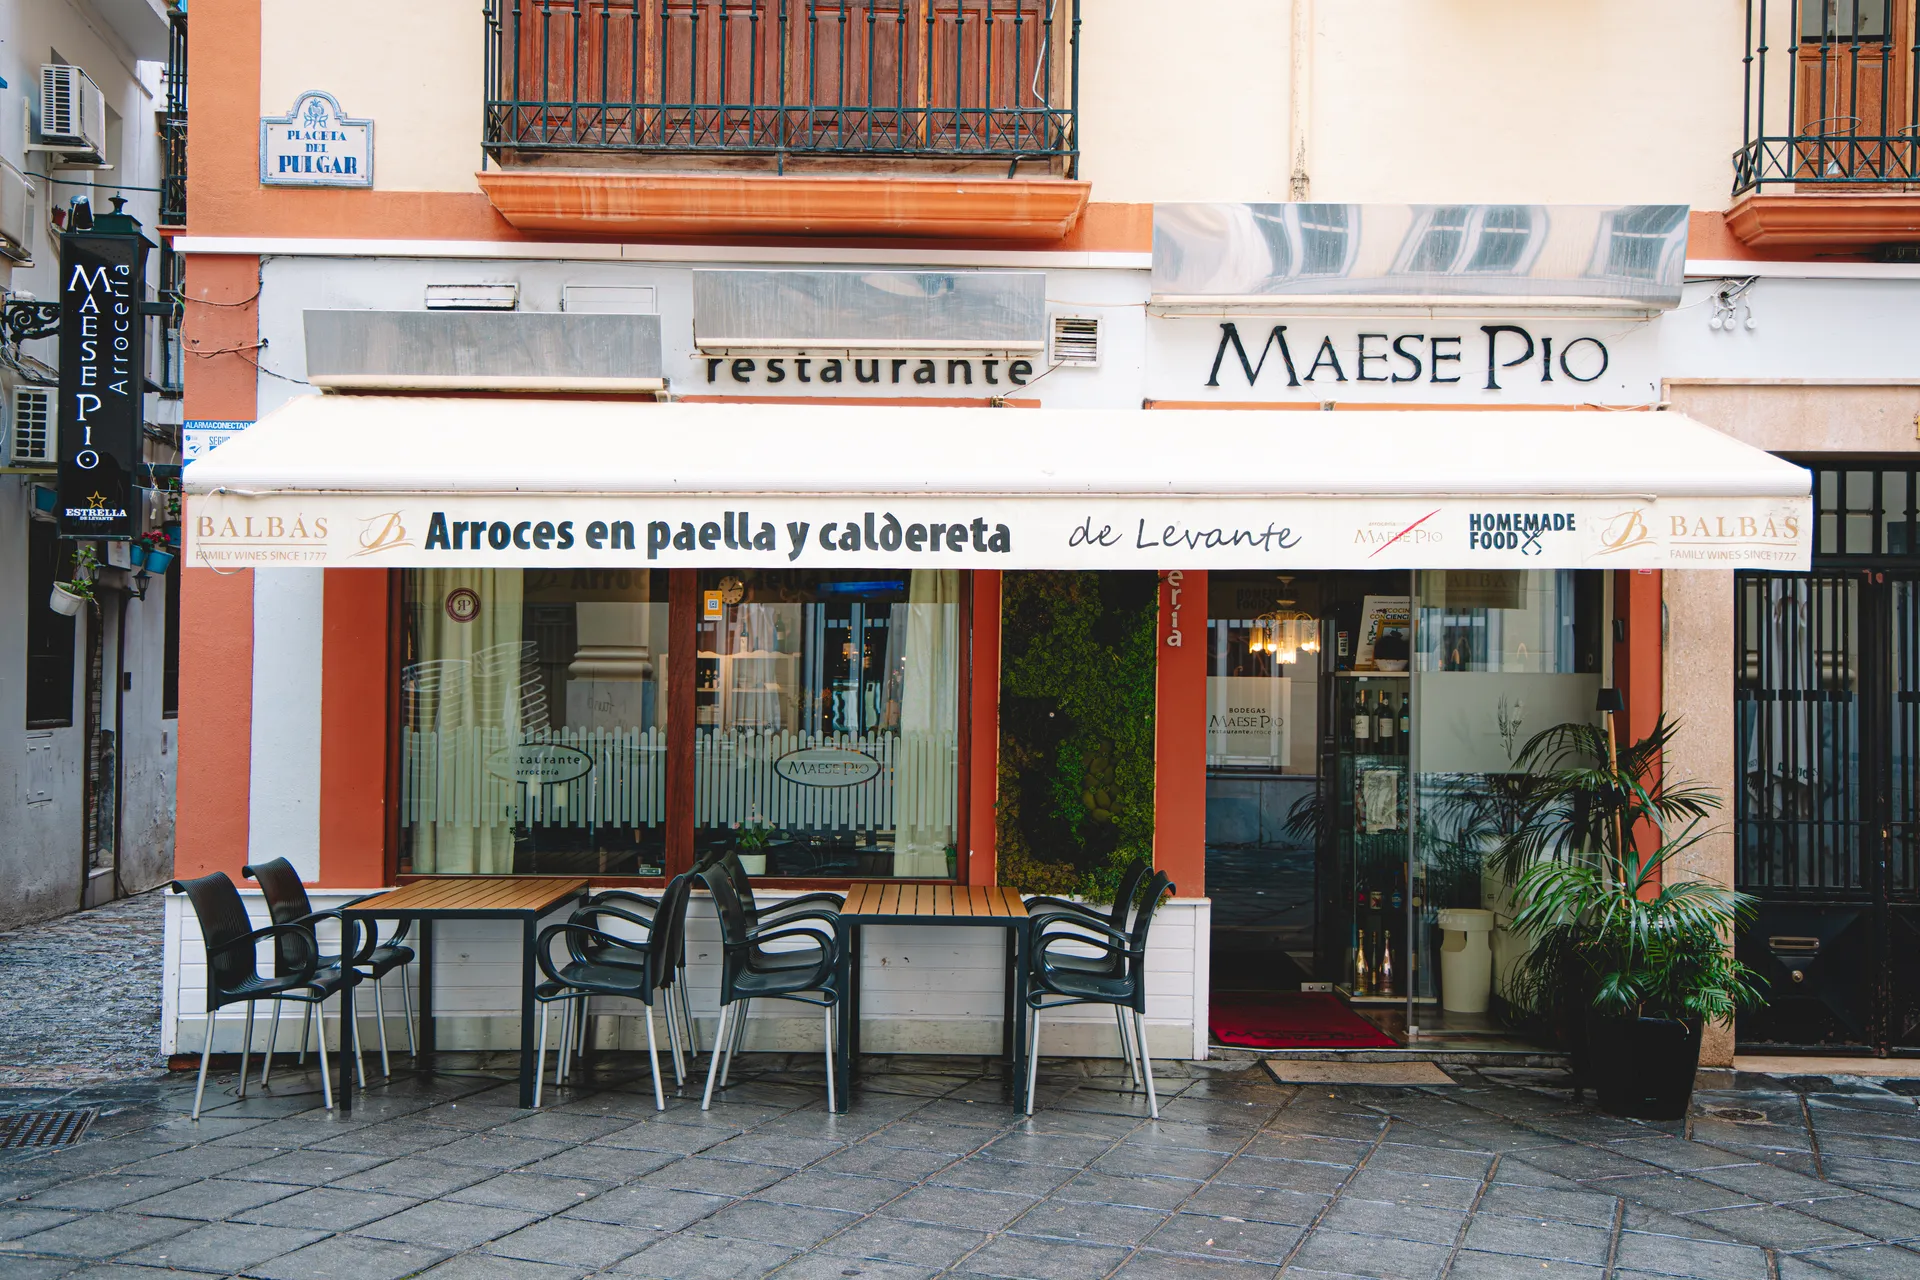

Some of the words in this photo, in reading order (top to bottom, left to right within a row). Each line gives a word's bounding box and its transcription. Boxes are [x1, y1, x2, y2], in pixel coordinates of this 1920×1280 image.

[287, 130, 347, 141] PLACETA
[305, 143, 329, 153] DEL
[278, 155, 357, 174] PULGAR
[67, 264, 112, 386] MAESE
[108, 264, 130, 395] Arrocería
[1204, 322, 1461, 387] MAESE
[1480, 325, 1609, 390] PIO
[706, 352, 1034, 386] restaurante
[75, 393, 102, 469] PIO
[65, 508, 127, 517] ESTRELLA
[196, 512, 329, 539] BALBÁS
[1469, 513, 1576, 531] HOMEMADE
[1670, 513, 1800, 540] BALBÁS
[425, 511, 574, 550] Arroces
[585, 520, 636, 550] en
[647, 511, 776, 560] paella
[786, 521, 811, 562] y
[819, 511, 1011, 553] caldereta
[1068, 516, 1123, 547] de
[1136, 518, 1302, 552] Levante
[1414, 529, 1443, 544] PIO
[1469, 532, 1518, 550] FOOD
[195, 551, 232, 560] FAMILY
[234, 551, 268, 561] WINES
[270, 551, 300, 561] SINCE
[303, 552, 328, 561] 1777
[1670, 550, 1705, 560] FAMILY
[1708, 550, 1741, 560] WINES
[1744, 550, 1772, 561] SINCE
[1773, 552, 1797, 562] 1777
[1209, 714, 1257, 728] MAESE
[1260, 715, 1284, 729] PIO
[497, 756, 581, 764] restaurante
[788, 761, 840, 775] MAESE
